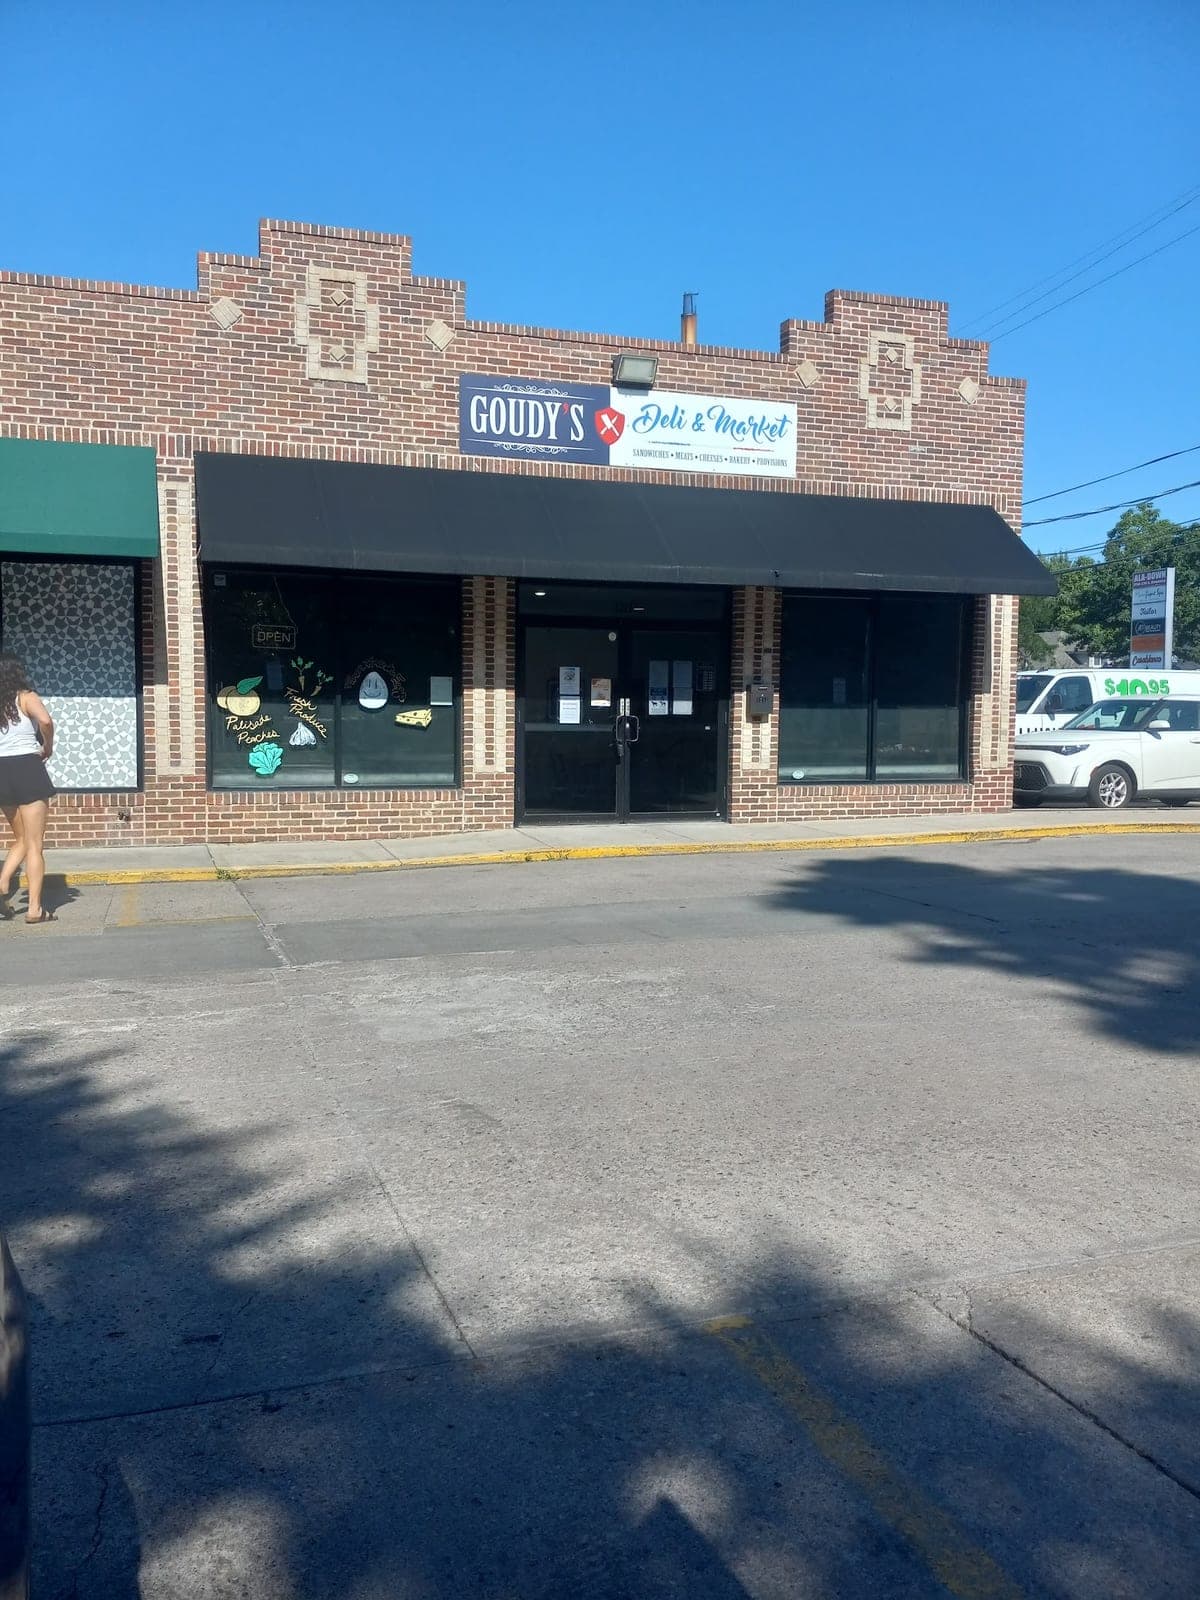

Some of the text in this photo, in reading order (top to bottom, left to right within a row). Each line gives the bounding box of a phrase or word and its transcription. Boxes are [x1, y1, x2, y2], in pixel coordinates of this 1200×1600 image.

[469, 395, 585, 442] GOUDY'S
[631, 403, 793, 444] Deli & Market
[632, 448, 788, 467] SANDWICHES MEATS CHEESES BAKERY PROVISIONS
[257, 631, 291, 642] OPEN
[283, 686, 318, 711] Fresh
[225, 714, 272, 730] Palisade
[289, 702, 328, 738] Produce
[237, 728, 281, 745] Peaches
